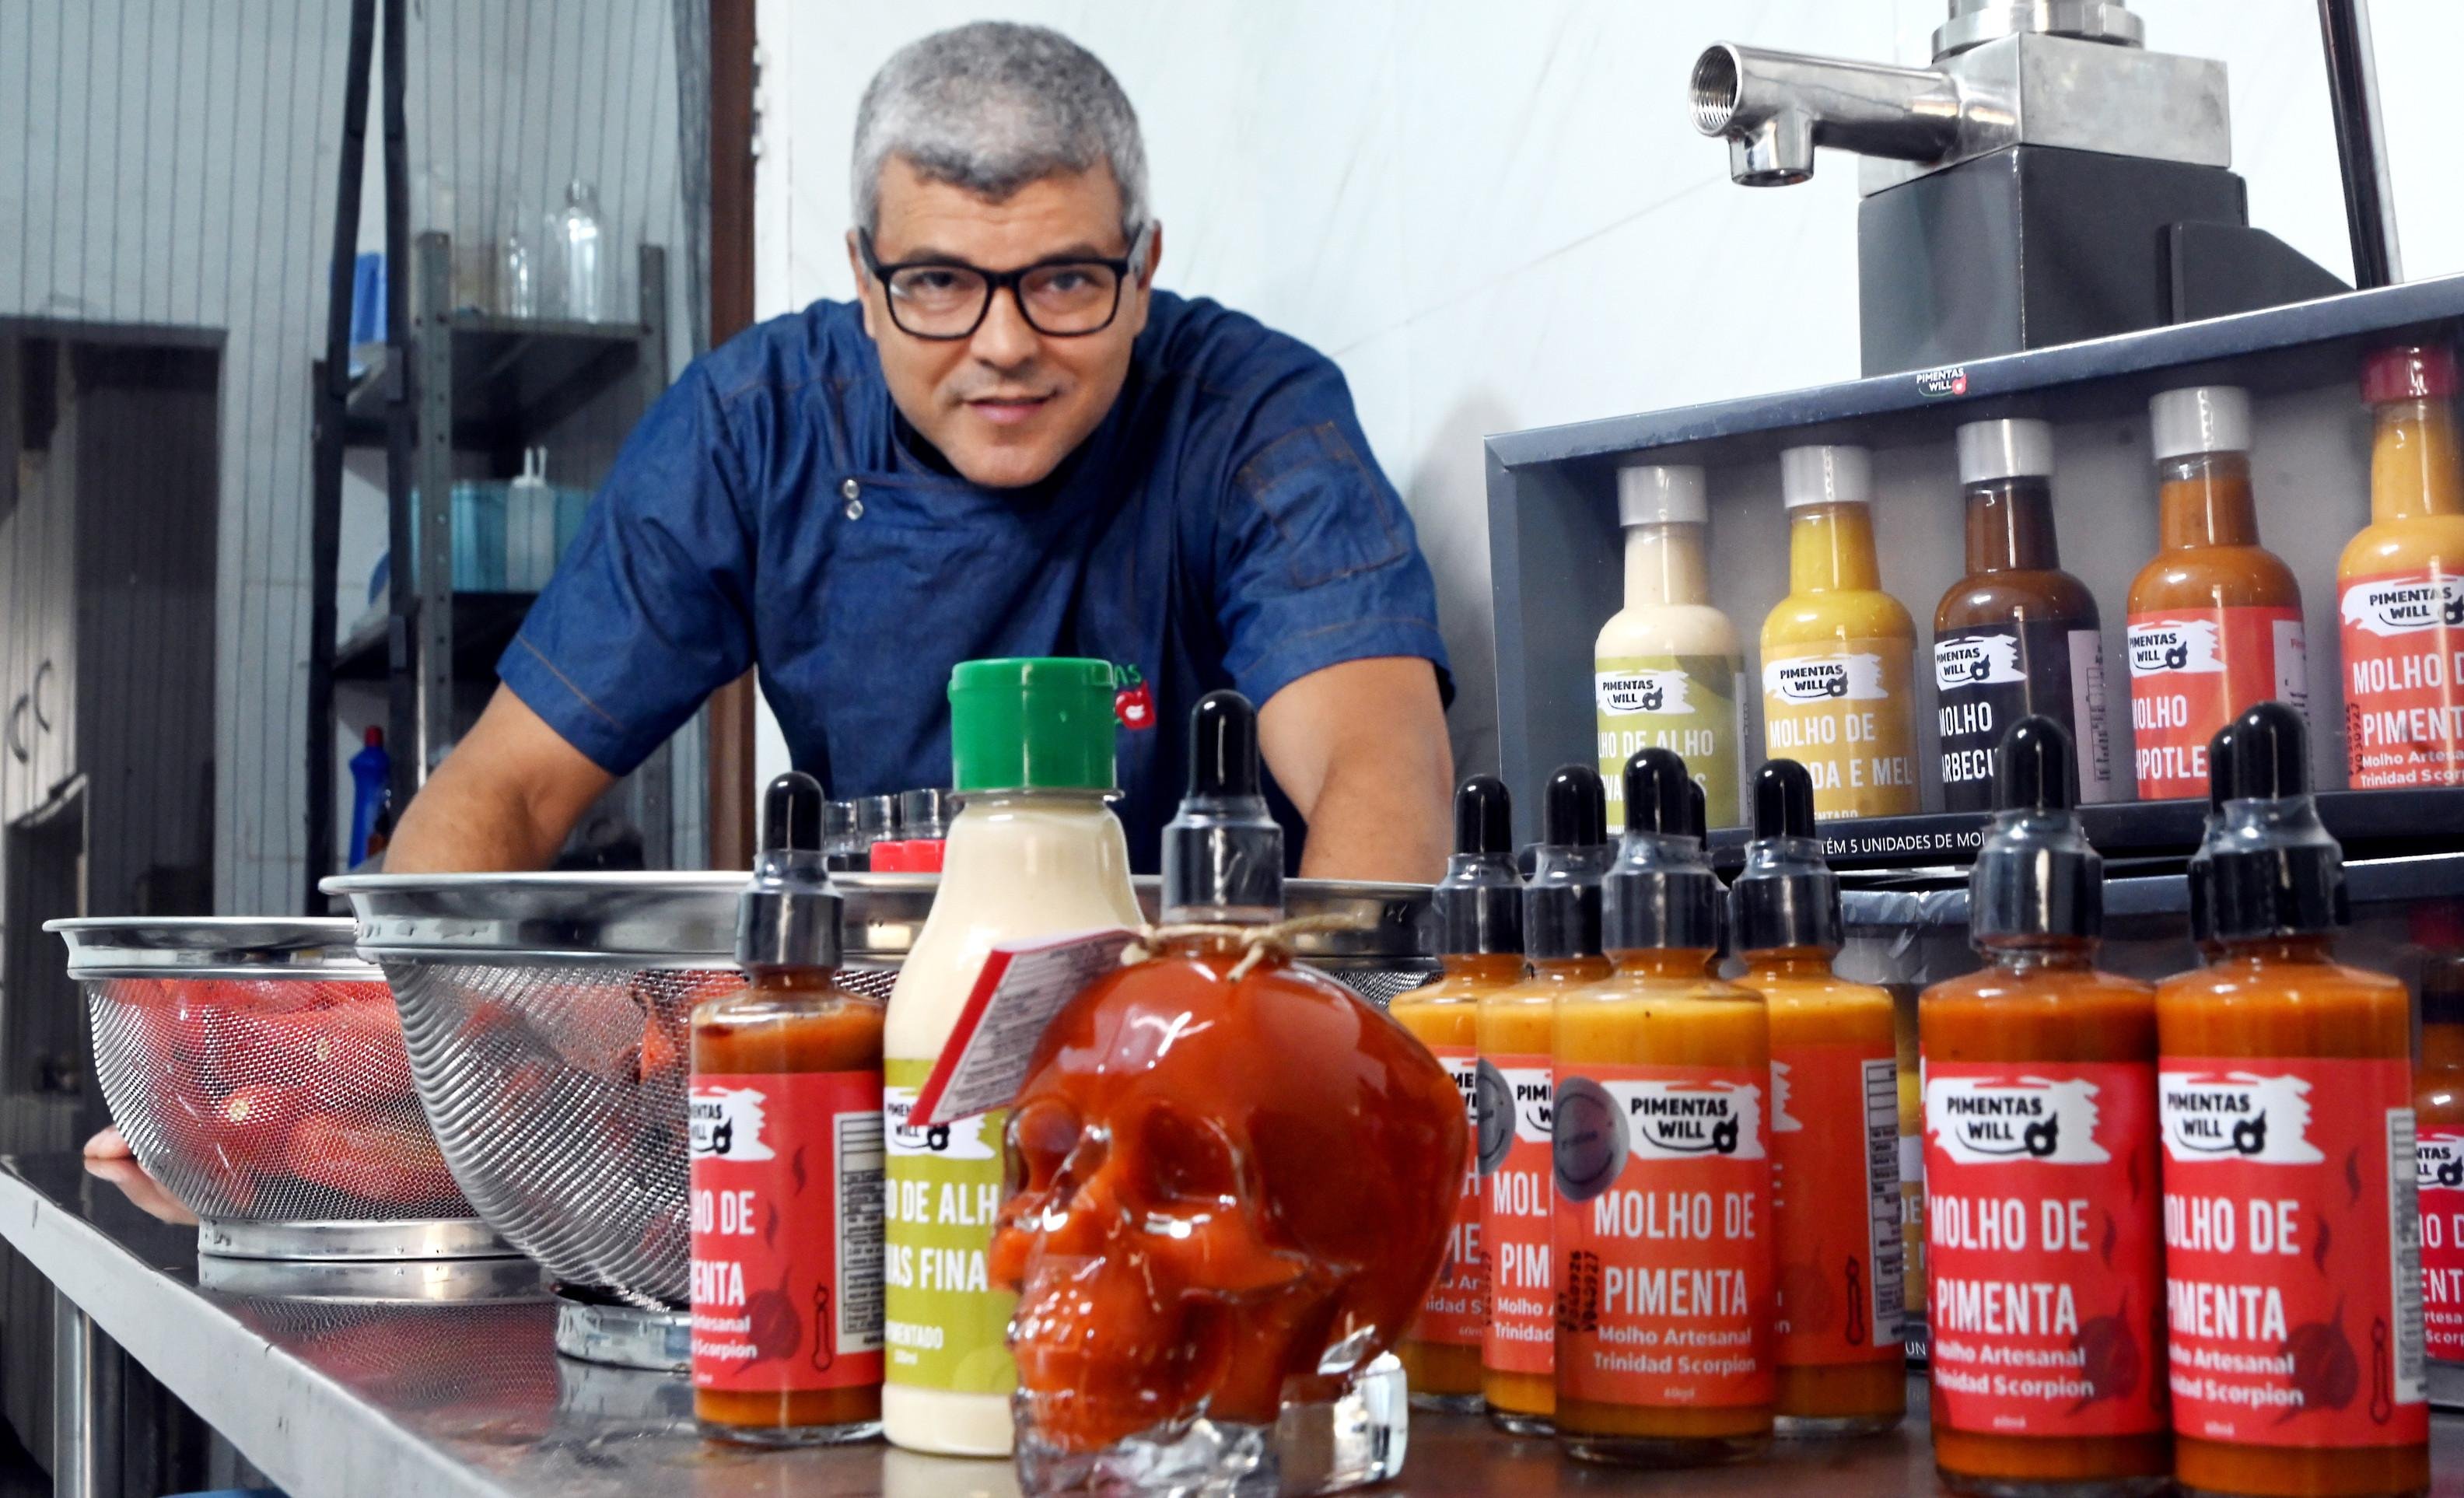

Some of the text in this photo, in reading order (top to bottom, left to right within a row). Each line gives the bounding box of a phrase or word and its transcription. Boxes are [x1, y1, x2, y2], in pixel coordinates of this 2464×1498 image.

[1916, 368, 1964, 383] PIMENTAS
[1929, 380, 1951, 392] WILL
[2370, 586, 2452, 606] PIMENTAS
[2390, 605, 2431, 620] WILL
[2130, 633, 2177, 648] PIMENTAS
[1937, 648, 1980, 664] PIMENTAS
[2137, 649, 2160, 662] WILL
[1780, 664, 1843, 679] PIMENTAS
[1944, 663, 1965, 676] WILL
[2353, 653, 2442, 695] MOLHO
[1603, 680, 1654, 691] PIMENTAS
[1794, 680, 1826, 691] WILL
[1613, 693, 1637, 704] WILL
[1770, 713, 1875, 748] MOLHO DE
[2363, 705, 2464, 747] PIMENT
[1598, 730, 1713, 758] LHO DE ALHO
[2136, 746, 2207, 781] IPOTLE
[2363, 752, 2403, 769] Molho
[1850, 759, 1864, 788] E
[1873, 757, 1913, 786] MEL
[2361, 769, 2417, 789] Trinidad
[1850, 839, 1857, 853] 5
[1862, 835, 1930, 852] UNIDADES
[1936, 833, 1952, 849] DE
[1631, 1097, 1727, 1116] PIMENTAS
[1947, 1097, 2042, 1115] PIMENTAS
[2168, 1094, 2250, 1112] PIMENTAS
[1657, 1121, 1705, 1139] WILL
[1968, 1122, 2014, 1140] WILL
[2183, 1119, 2222, 1137] WILL
[901, 1180, 930, 1223] DE
[938, 1182, 999, 1226] ALH
[1493, 1171, 1554, 1216] MOL
[720, 1190, 755, 1235] DE
[1594, 1191, 1755, 1240] MOLHO DE
[1931, 1196, 2090, 1251] MOLHO DE
[2249, 1199, 2300, 1255] DE
[919, 1247, 989, 1293] FINA
[1501, 1243, 1554, 1289] PIM
[691, 1260, 745, 1306] ENTA
[1605, 1266, 1748, 1317] PIMENTA
[1498, 1297, 1543, 1316] Molho
[1937, 1277, 2078, 1335] PIMENTA
[1598, 1325, 1751, 1346] Molho Artesanal
[1594, 1352, 1756, 1377] Trinidad Scorpion
[1980, 1345, 2086, 1367] Artesanal
[2194, 1347, 2295, 1374] Artesanal
[1993, 1374, 2095, 1401] Scorpion
[2205, 1378, 2305, 1411] Scorpion
